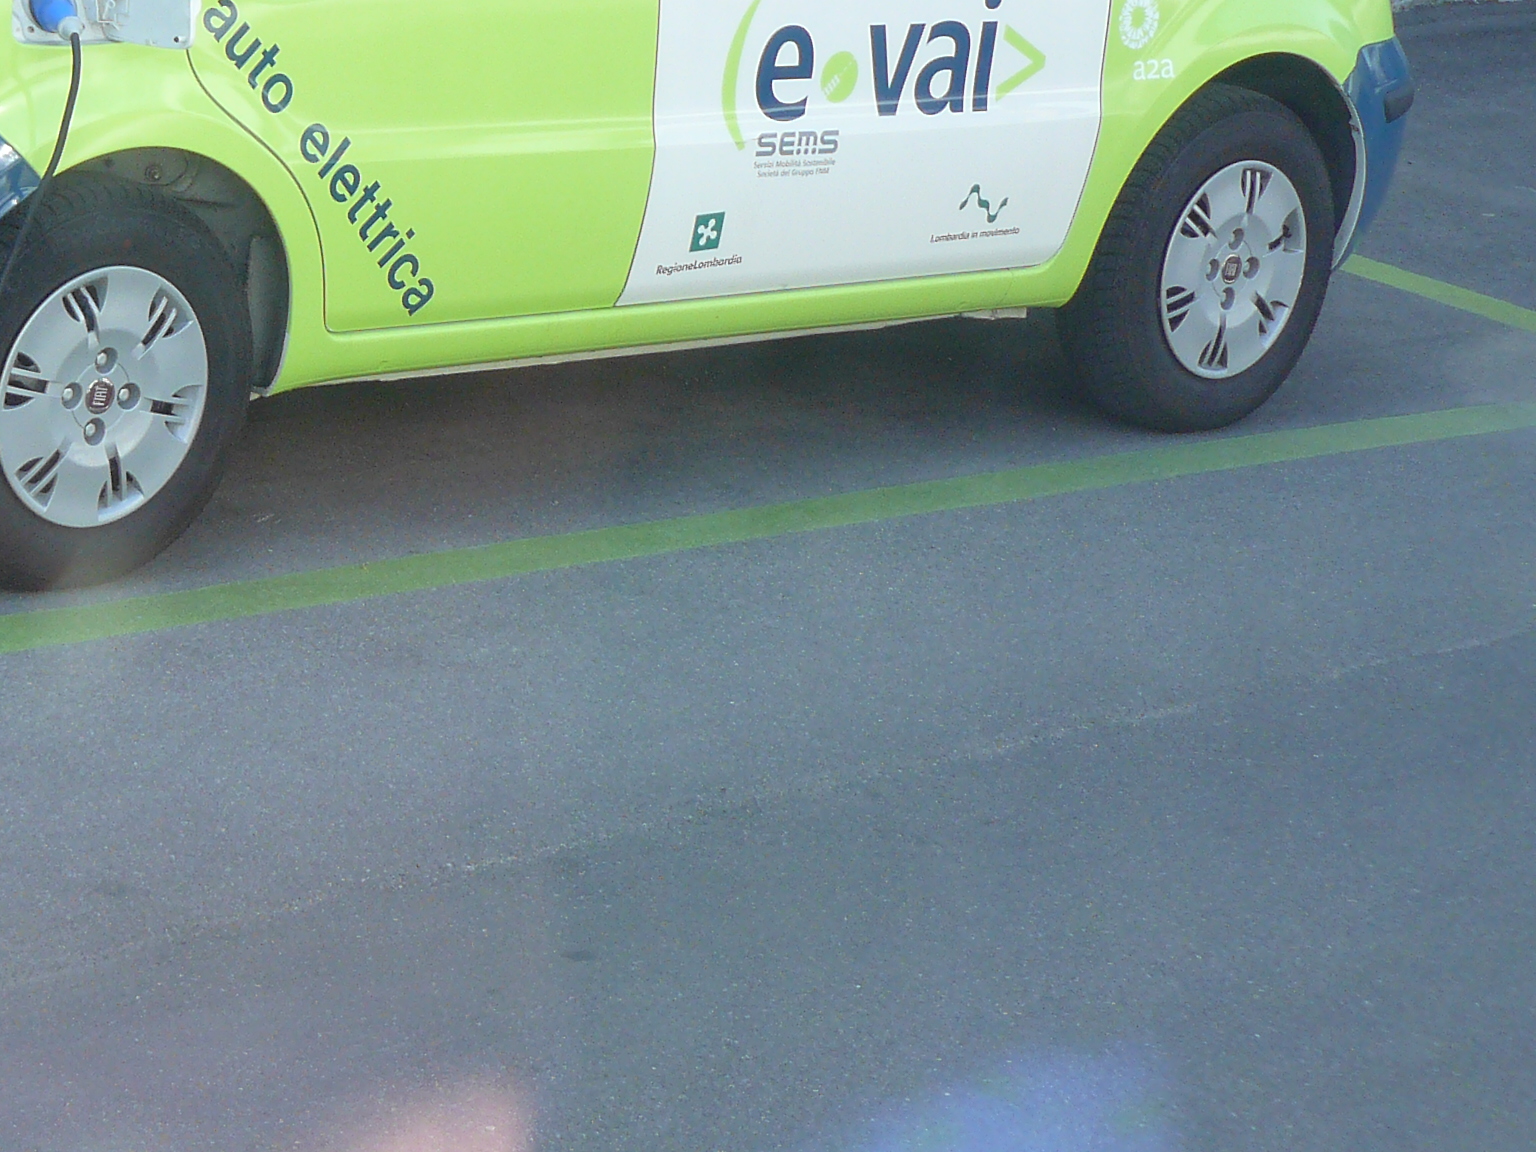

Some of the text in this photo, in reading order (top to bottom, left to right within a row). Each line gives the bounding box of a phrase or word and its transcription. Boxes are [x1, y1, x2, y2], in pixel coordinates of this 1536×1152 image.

[1133, 58, 1175, 81] a2a
[300, 122, 435, 316] elettrica
[930, 232, 970, 243] Lombardia
[979, 227, 1020, 237] movimento
[656, 254, 742, 275] RegioneLombardia
[92, 386, 108, 406] FIAT
